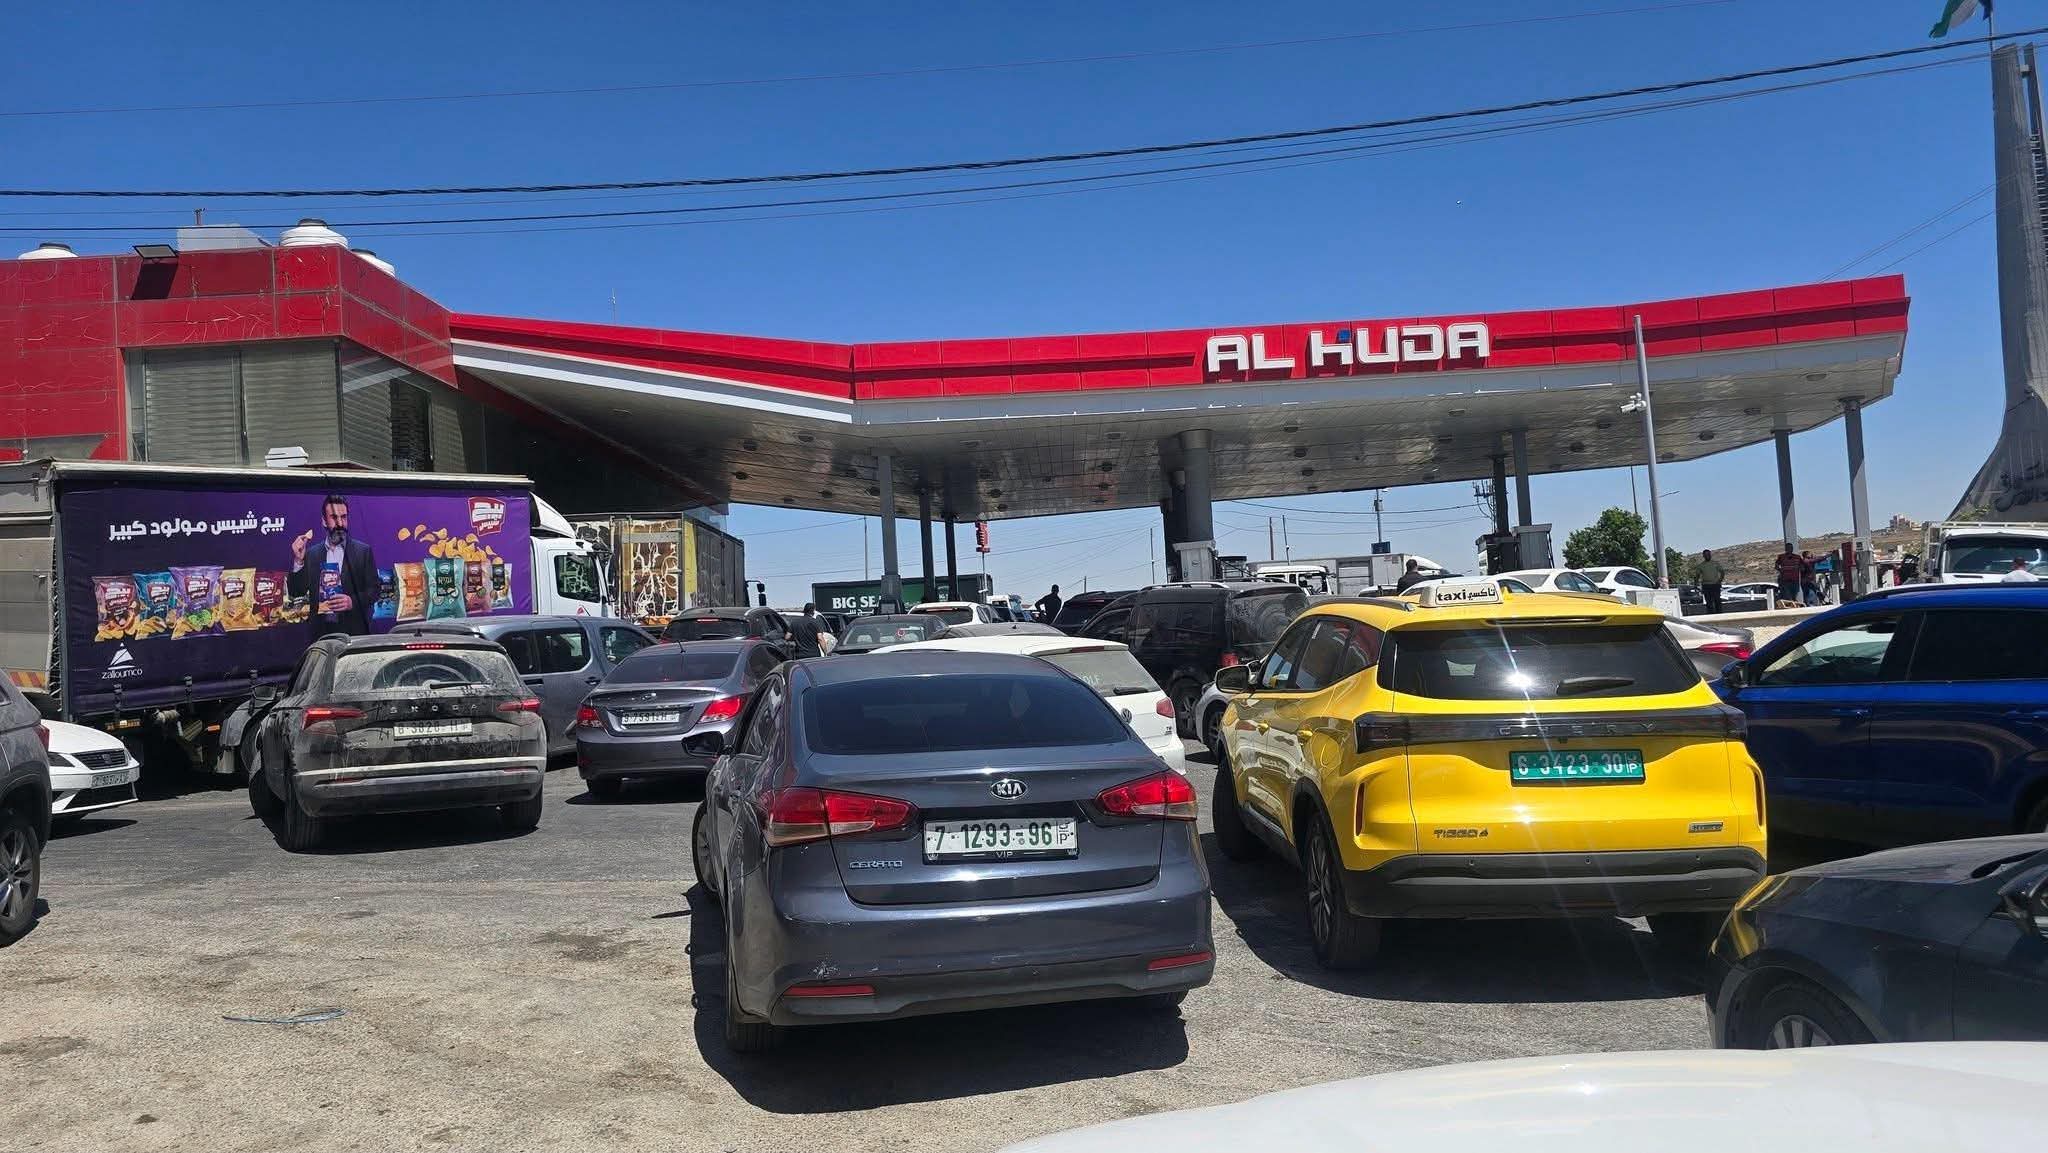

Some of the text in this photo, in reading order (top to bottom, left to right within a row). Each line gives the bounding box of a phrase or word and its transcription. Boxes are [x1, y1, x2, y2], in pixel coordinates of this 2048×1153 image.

[1206, 321, 1490, 372] AL HUDA
[108, 519, 147, 541] كبير
[150, 517, 208, 538] مولود
[261, 516, 285, 535] بيج
[1437, 589, 1467, 601] taxi
[1467, 587, 1496, 601] تاكسي
[832, 597, 857, 609] BIG
[101, 668, 143, 680] zalloumco
[996, 782, 1023, 796] KIA
[995, 850, 1014, 859] VIP
[849, 860, 904, 869] CERATO
